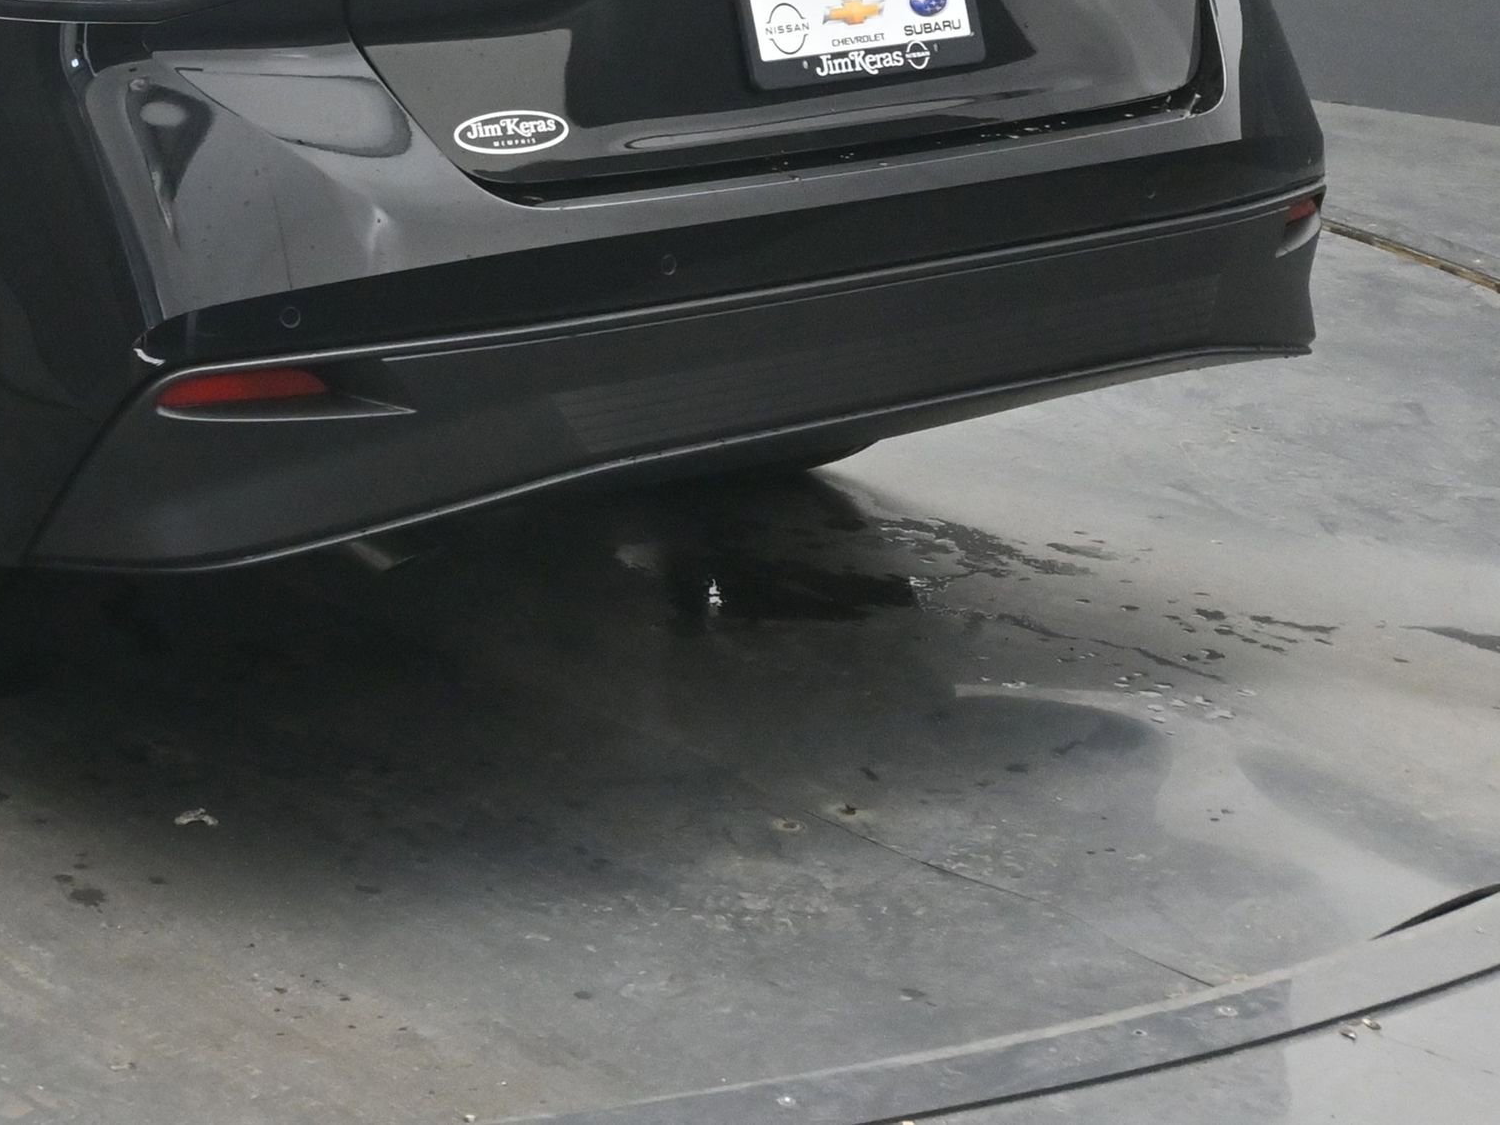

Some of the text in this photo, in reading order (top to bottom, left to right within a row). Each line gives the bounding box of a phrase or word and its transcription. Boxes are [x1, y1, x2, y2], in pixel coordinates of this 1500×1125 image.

[765, 22, 810, 35] NISSAN
[904, 19, 961, 36] SUBARU
[832, 33, 885, 46] CHEVROLET
